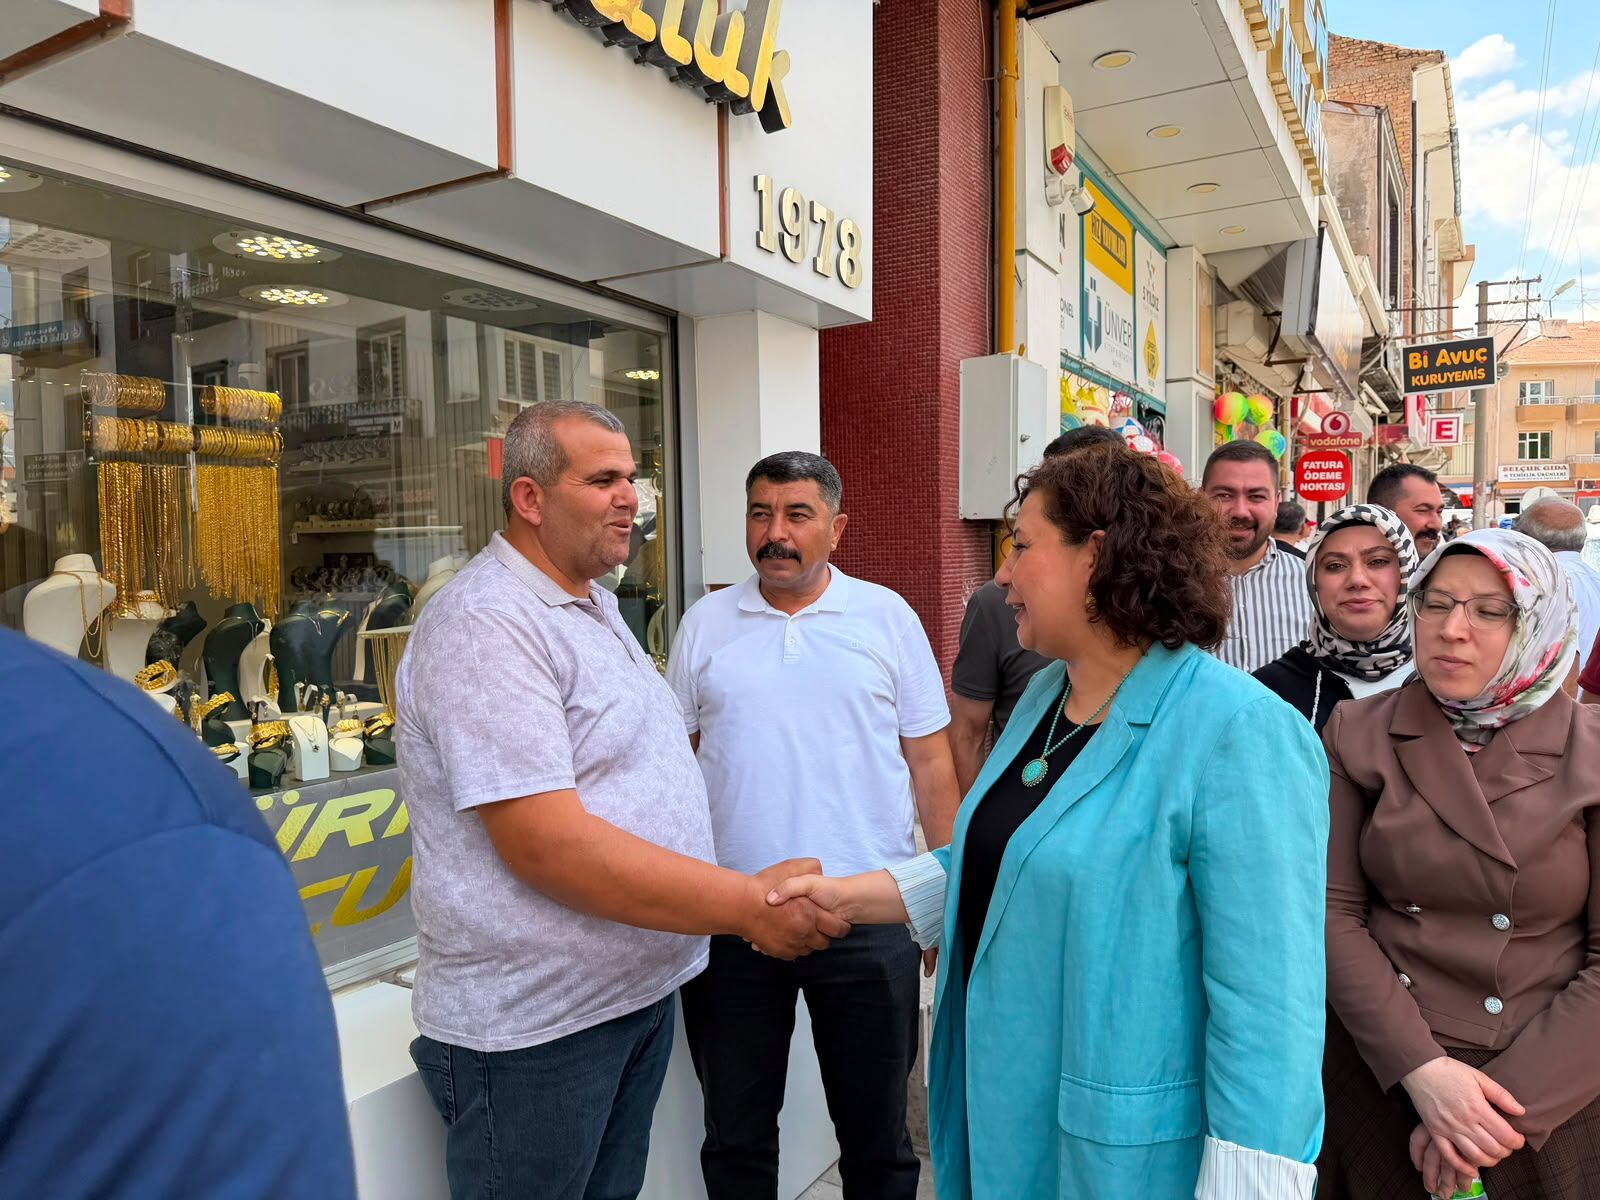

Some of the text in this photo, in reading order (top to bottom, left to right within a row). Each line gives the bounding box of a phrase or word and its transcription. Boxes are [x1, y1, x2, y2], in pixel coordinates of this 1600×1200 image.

[753, 174, 863, 289] 1978
[1104, 301, 1133, 350] ÜNVER
[1435, 420, 1454, 440] E
[1310, 436, 1360, 446] vodafone
[1303, 460, 1344, 470] FATURA
[1304, 470, 1342, 480] ÖDEME
[1300, 482, 1345, 491] NOKTASI
